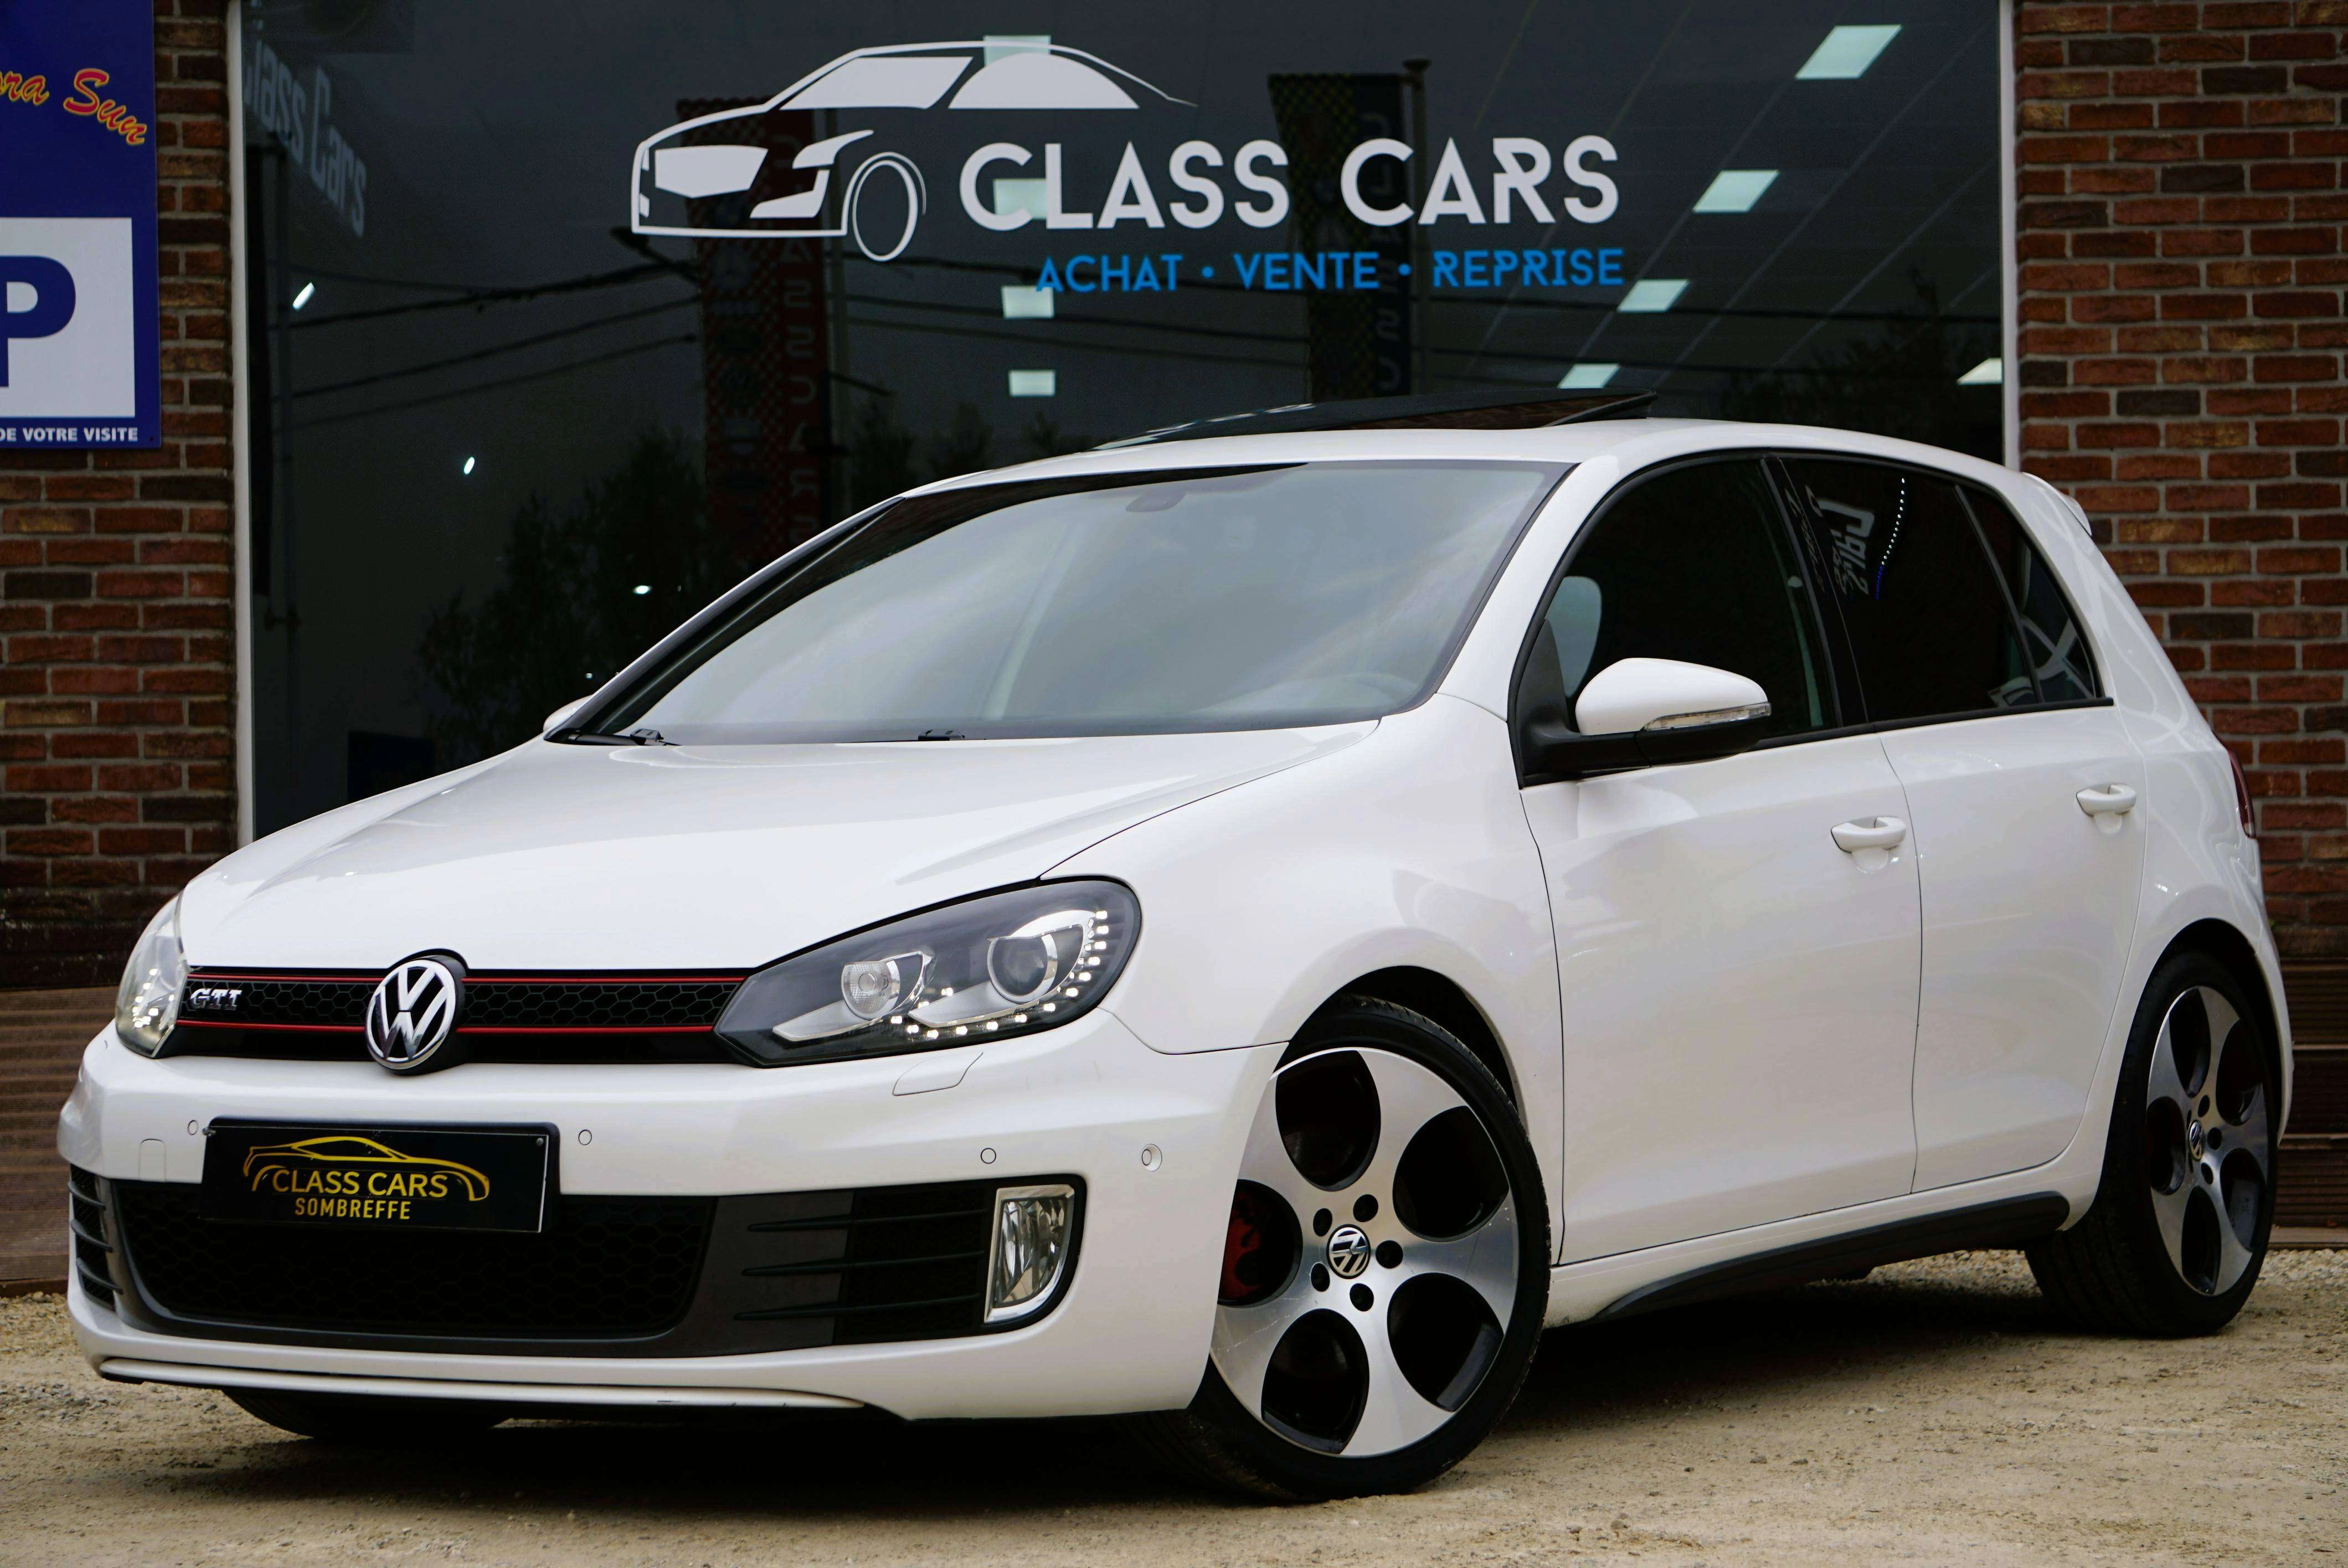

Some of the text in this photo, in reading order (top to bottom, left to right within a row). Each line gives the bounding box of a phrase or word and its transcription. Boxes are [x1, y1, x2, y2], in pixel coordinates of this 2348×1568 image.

[0, 68, 147, 145] ra Sun
[311, 66, 367, 237] Cars
[959, 135, 1619, 231] CLASS CARS
[1036, 248, 1624, 292] ACHAT VENTE REPRISE
[22, 427, 78, 442] VOTRE
[83, 427, 138, 442] VISITE
[189, 988, 242, 1010] GTI
[272, 1170, 448, 1198] CLASS CARS
[295, 1198, 411, 1220] SOMBREFFE
